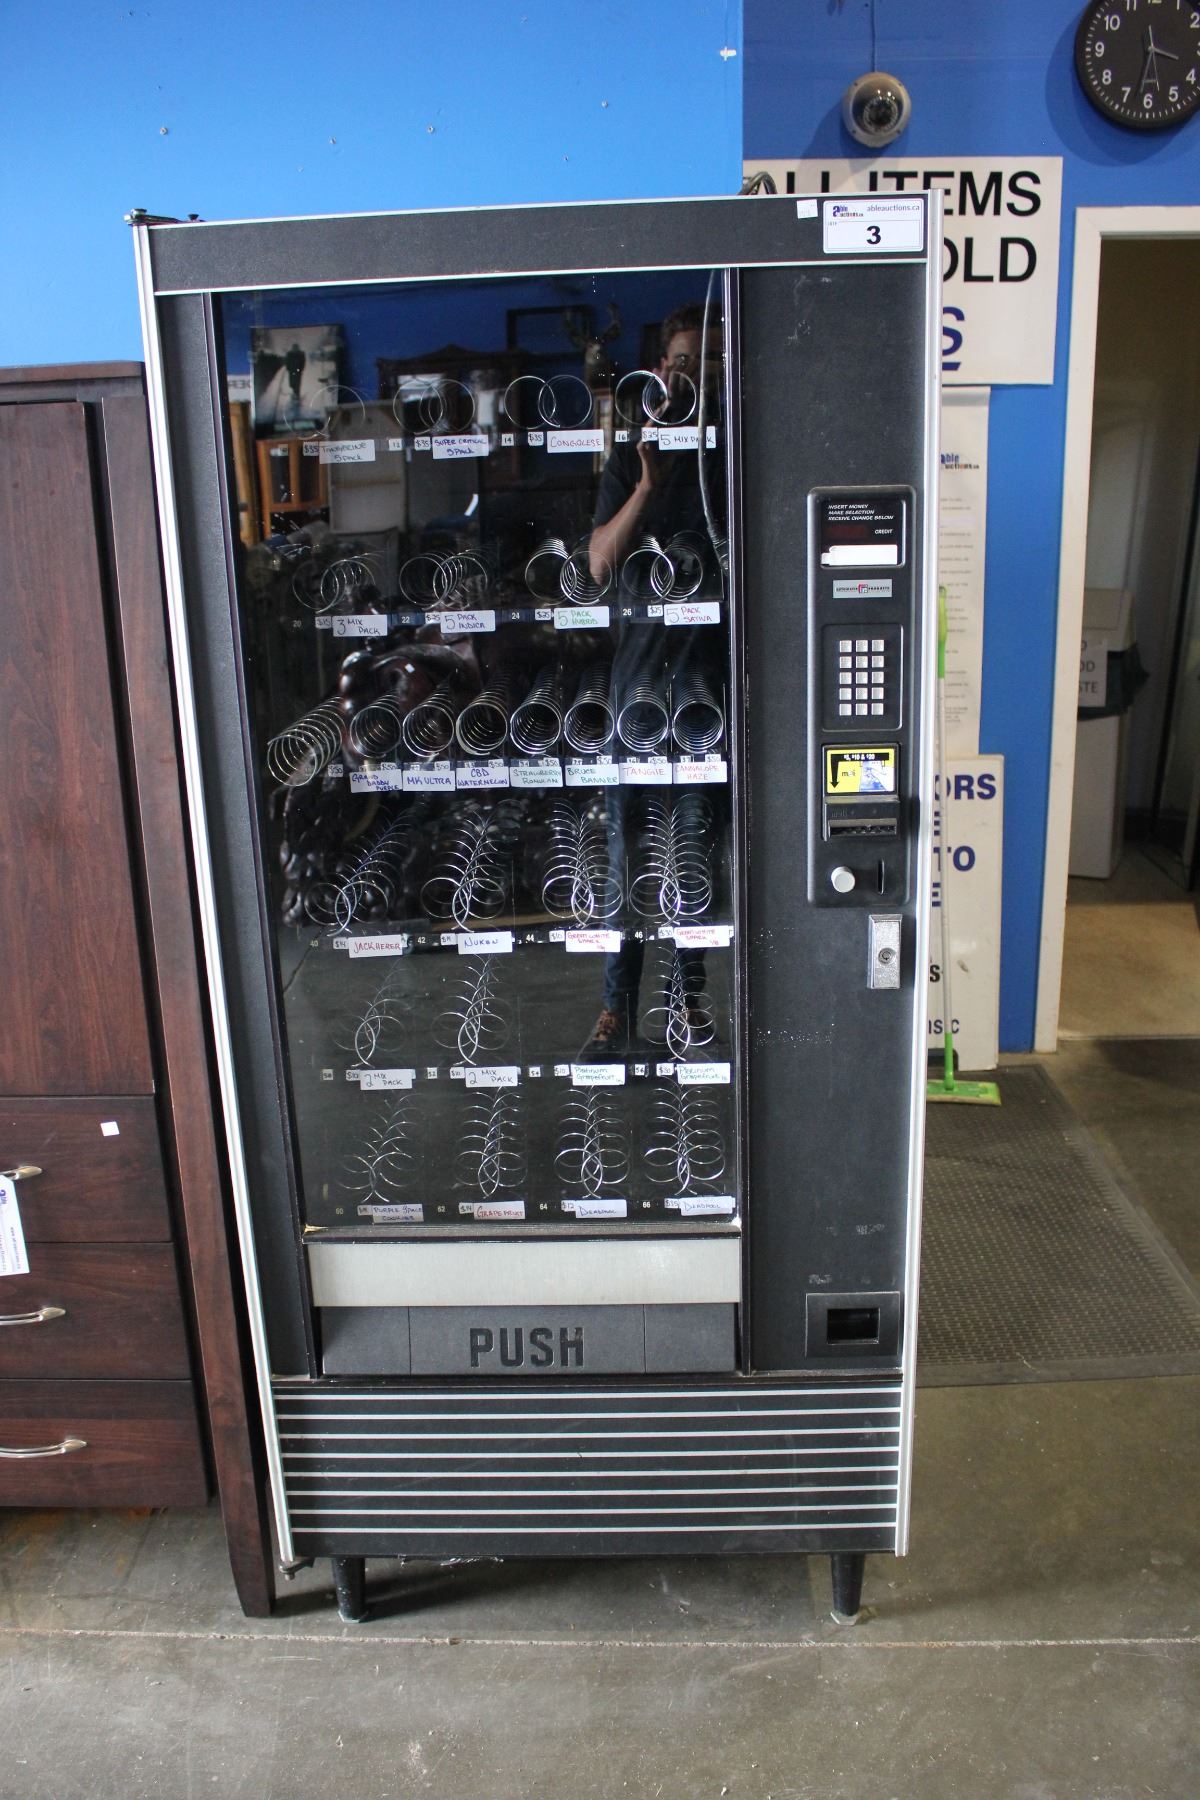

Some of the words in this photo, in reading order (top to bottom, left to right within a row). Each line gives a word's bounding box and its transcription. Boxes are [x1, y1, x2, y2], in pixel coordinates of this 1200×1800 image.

[1104, 14, 1121, 31] 10
[1189, 12, 1200, 29] 2
[1095, 41, 1105, 58] 9
[1101, 69, 1112, 85] 8
[1185, 68, 1196, 85] 4
[1121, 86, 1131, 103] 7
[1168, 86, 1179, 102] 5
[1143, 93, 1153, 109] 6
[866, 203, 920, 213] ableauctions.ca
[866, 225, 882, 245] 3
[504, 436, 512, 444] 14
[529, 433, 542, 442] $35
[550, 436, 601, 448] CONGOLESE
[618, 433, 626, 442] 16
[660, 433, 671, 446] 5
[416, 439, 429, 448] $35
[511, 612, 520, 620] 24
[622, 607, 632, 616] 26
[666, 607, 679, 624] 5
[401, 616, 410, 624] 22
[444, 615, 455, 630] 5
[457, 613, 477, 622] PACK
[556, 610, 568, 627] 5
[336, 619, 346, 636] 3
[347, 617, 363, 625] MIX
[358, 626, 380, 636] PACK
[470, 768, 490, 778] CBD
[566, 767, 595, 775] BRUCE
[407, 777, 422, 785] MK
[424, 777, 452, 785] ULTRA
[580, 775, 618, 783] BANNER
[417, 936, 426, 944] 42
[526, 934, 535, 942] 44
[634, 931, 643, 939] 46
[310, 940, 319, 948] 40
[364, 1073, 374, 1088] 2
[468, 1071, 478, 1085] 2
[491, 1076, 514, 1084] PACK
[437, 1205, 446, 1213] 62
[642, 1201, 651, 1209] 66
[335, 1207, 344, 1215] 60
[469, 1327, 585, 1368] PUSH
